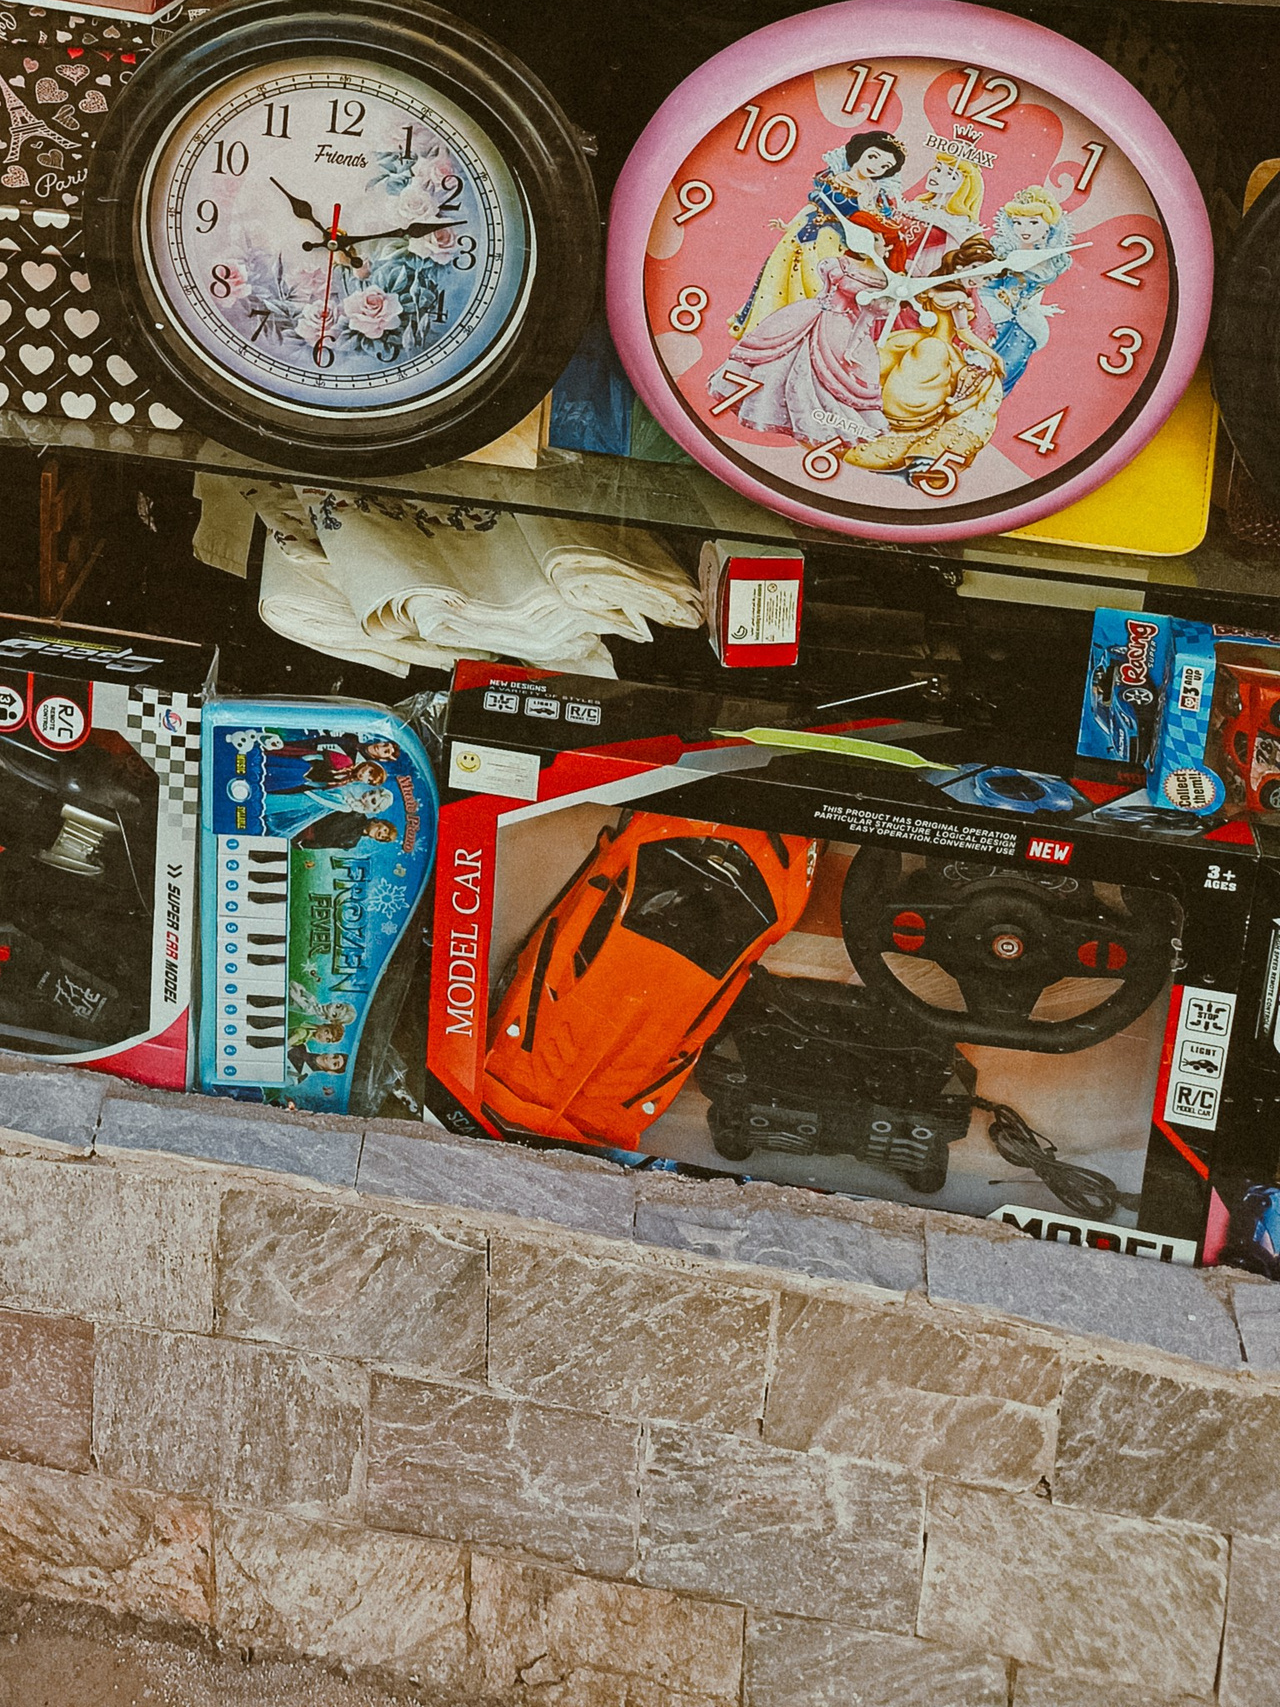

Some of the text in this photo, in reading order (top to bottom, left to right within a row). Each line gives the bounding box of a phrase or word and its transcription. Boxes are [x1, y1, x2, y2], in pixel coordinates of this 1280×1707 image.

[950, 66, 1022, 129] 12
[734, 103, 799, 164] 10
[924, 132, 998, 170] BROMAX
[313, 142, 370, 170] Friends
[674, 179, 714, 227] 9
[1107, 233, 1156, 288] 2
[668, 285, 709, 334] 8
[1097, 326, 1144, 376] 3
[709, 369, 764, 417] 7
[810, 408, 882, 441] QUARTZ
[1017, 406, 1069, 456] 4
[801, 435, 842, 481] 6
[916, 451, 966, 497] 5
[1121, 620, 1159, 686] Racing
[1147, 640, 1157, 669] SUPER
[489, 679, 548, 693] NEW DESIGNS
[1184, 668, 1194, 686] AND
[1193, 669, 1203, 682] UP
[500, 687, 601, 705] VARIETY STYLES
[570, 705, 598, 719] R/C
[1186, 687, 1200, 702] 3
[42, 704, 51, 734] CONTROL
[49, 705, 57, 732] REMOTE
[58, 703, 75, 740] R/C
[235, 753, 246, 775] MUSIC
[1176, 772, 1193, 809] Collect
[1191, 770, 1207, 806] them!!
[403, 814, 421, 854] Piano
[814, 810, 1017, 850] PARTICULAR STRUCTURE LOGICAL DESIGN
[822, 804, 1018, 842] THIS PRODUCT HAS ORIGINAL OPERATION
[849, 823, 1016, 857] EASY USE
[1028, 841, 1070, 861] NEW
[1204, 880, 1238, 892] AGES
[1207, 865, 1237, 882] 3+
[163, 882, 181, 1004] SUPER CAR MODEL
[308, 892, 333, 959] FEVER
[329, 855, 372, 995] FROZEN
[446, 846, 483, 1039] MODEL CAR
[1262, 950, 1280, 1028] SPEED REMOTE CONTROL
[1196, 1010, 1220, 1021] STOP
[1191, 1045, 1217, 1057] LIGHT
[1176, 1105, 1213, 1117] MODEL CAR
[1177, 1086, 1215, 1109] R/C
